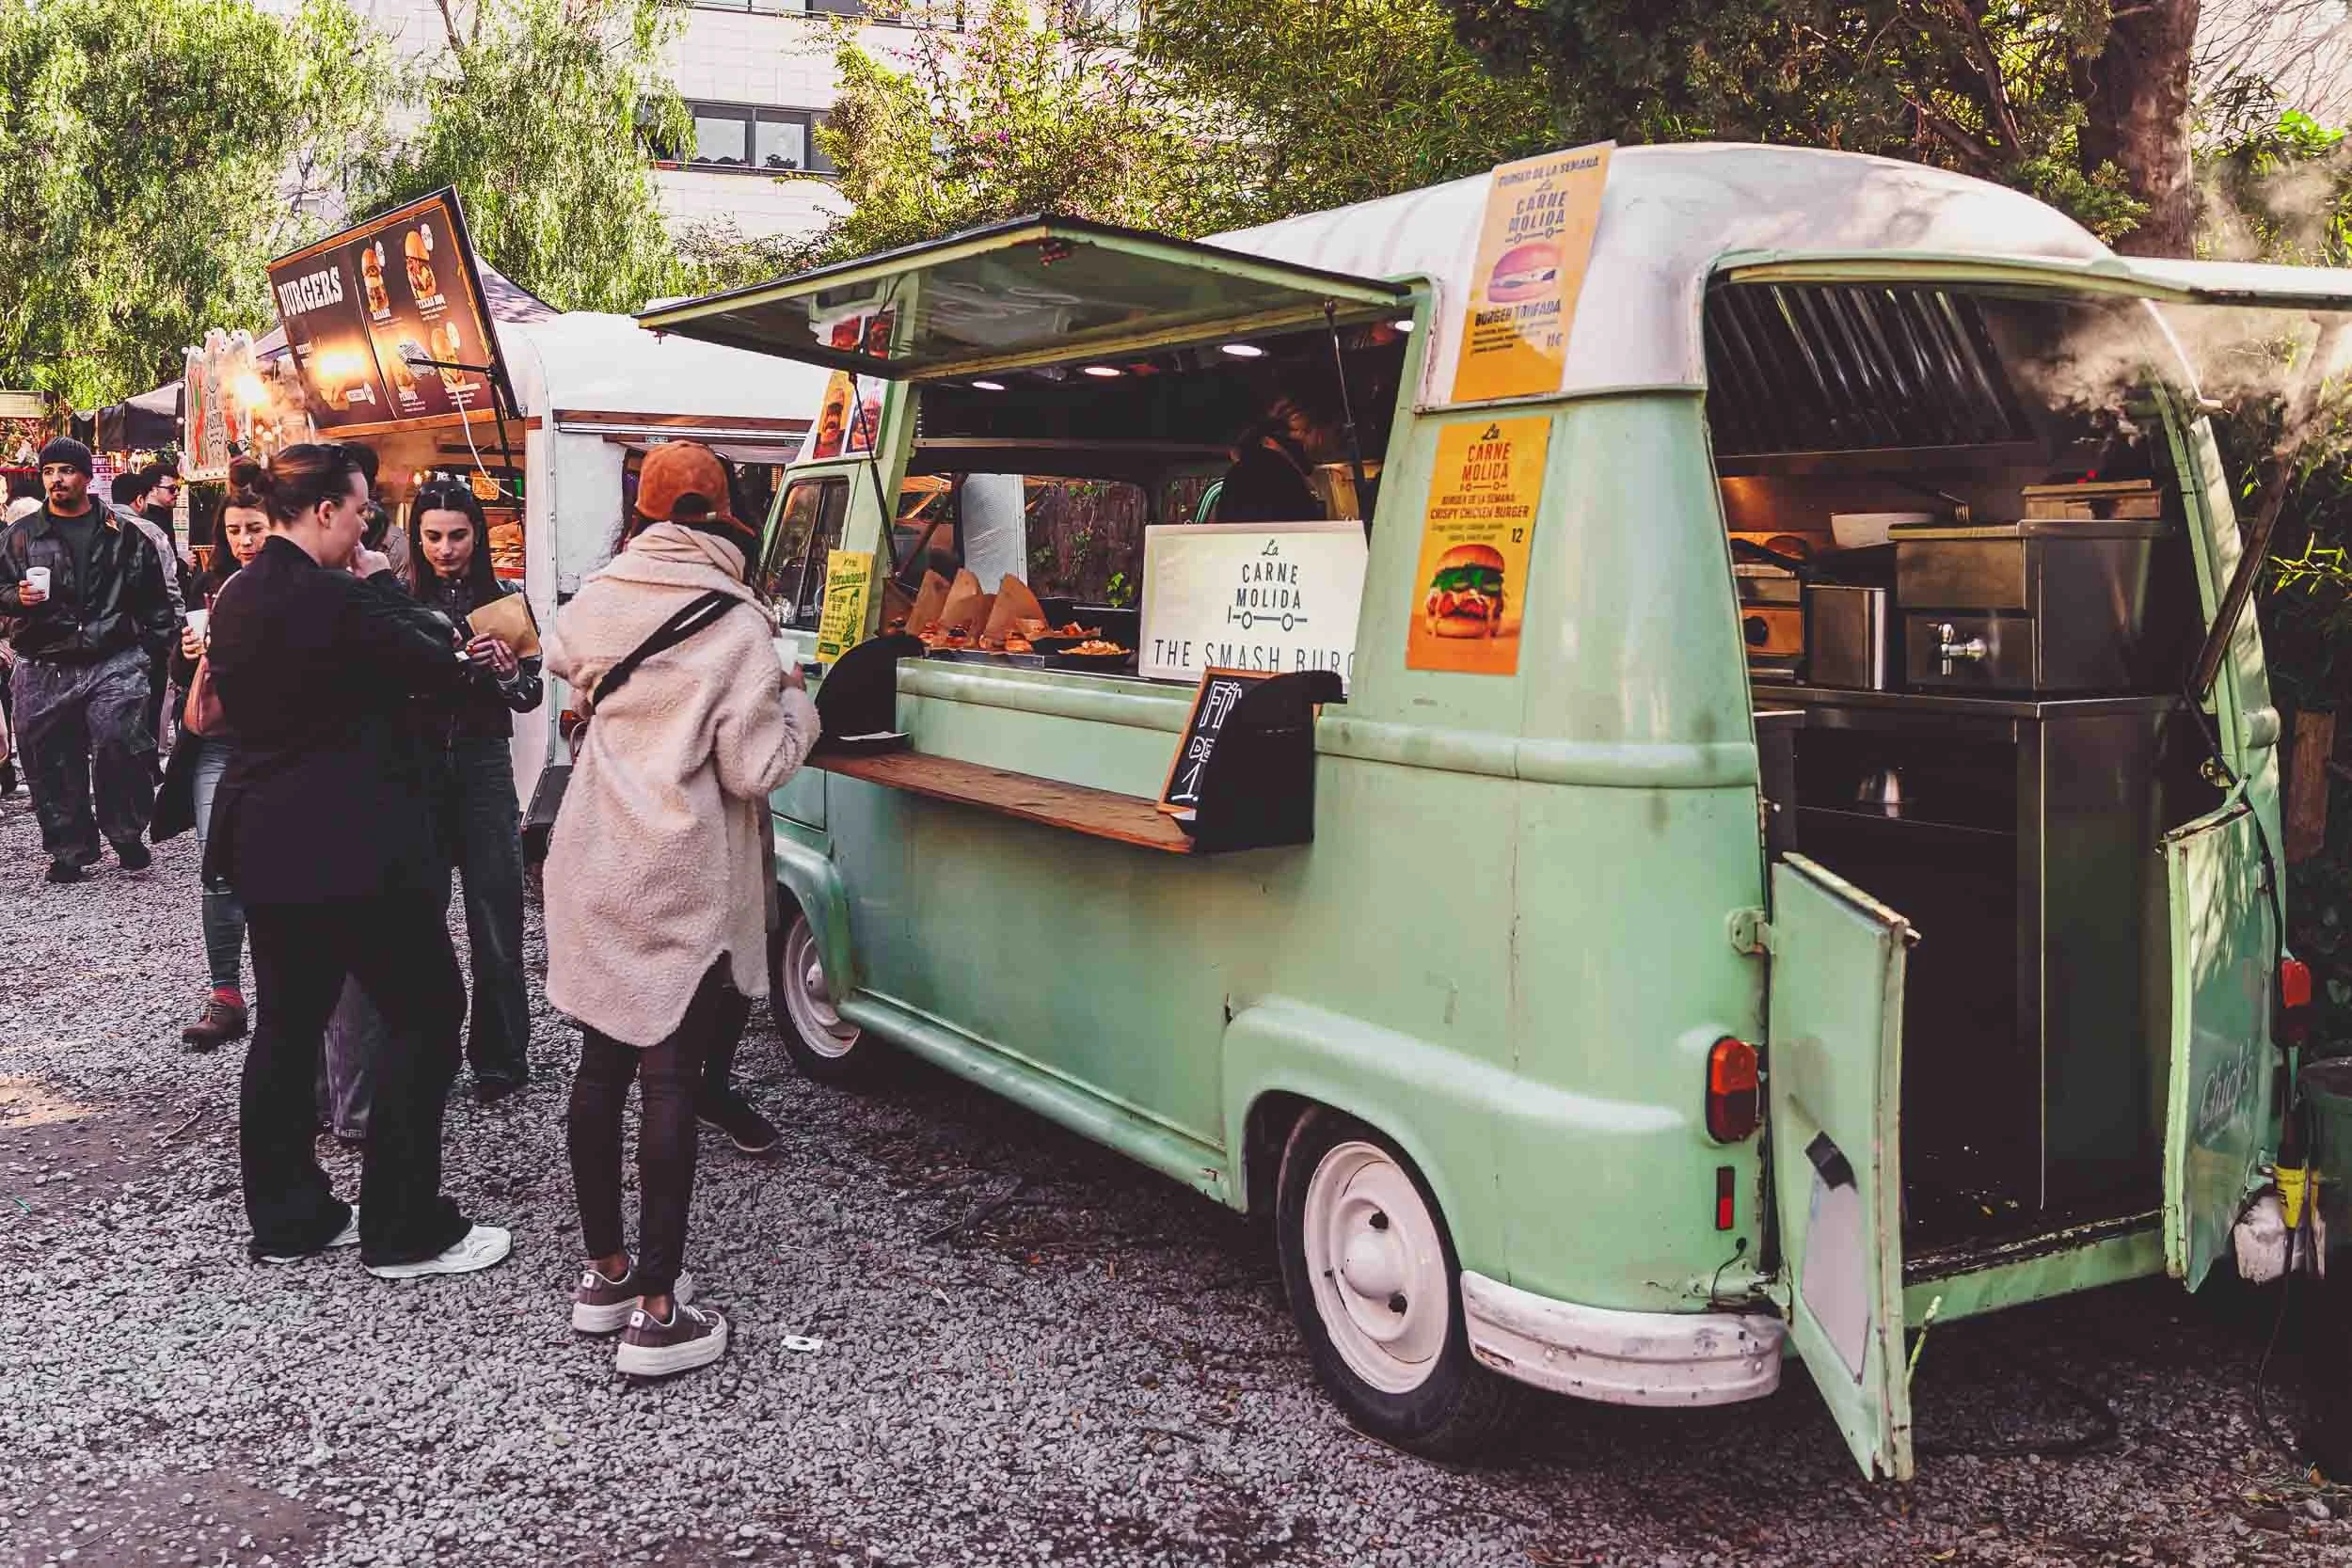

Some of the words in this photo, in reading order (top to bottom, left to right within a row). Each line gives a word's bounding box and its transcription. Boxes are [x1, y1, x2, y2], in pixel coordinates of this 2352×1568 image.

[1517, 190, 1567, 214] CARNE
[1509, 209, 1565, 233] MOLIDA
[278, 265, 343, 317] BURGERS
[1468, 442, 1512, 463] CARNE
[1462, 463, 1509, 483] MOLIDA
[1494, 504, 1531, 519] BURGER
[1511, 527, 1524, 544] 12
[1262, 538, 1279, 556] La
[1242, 562, 1299, 585] CARNE
[1236, 588, 1302, 610] MOLIDA
[1154, 639, 1192, 668] THE
[1204, 642, 1280, 673] SMASH
